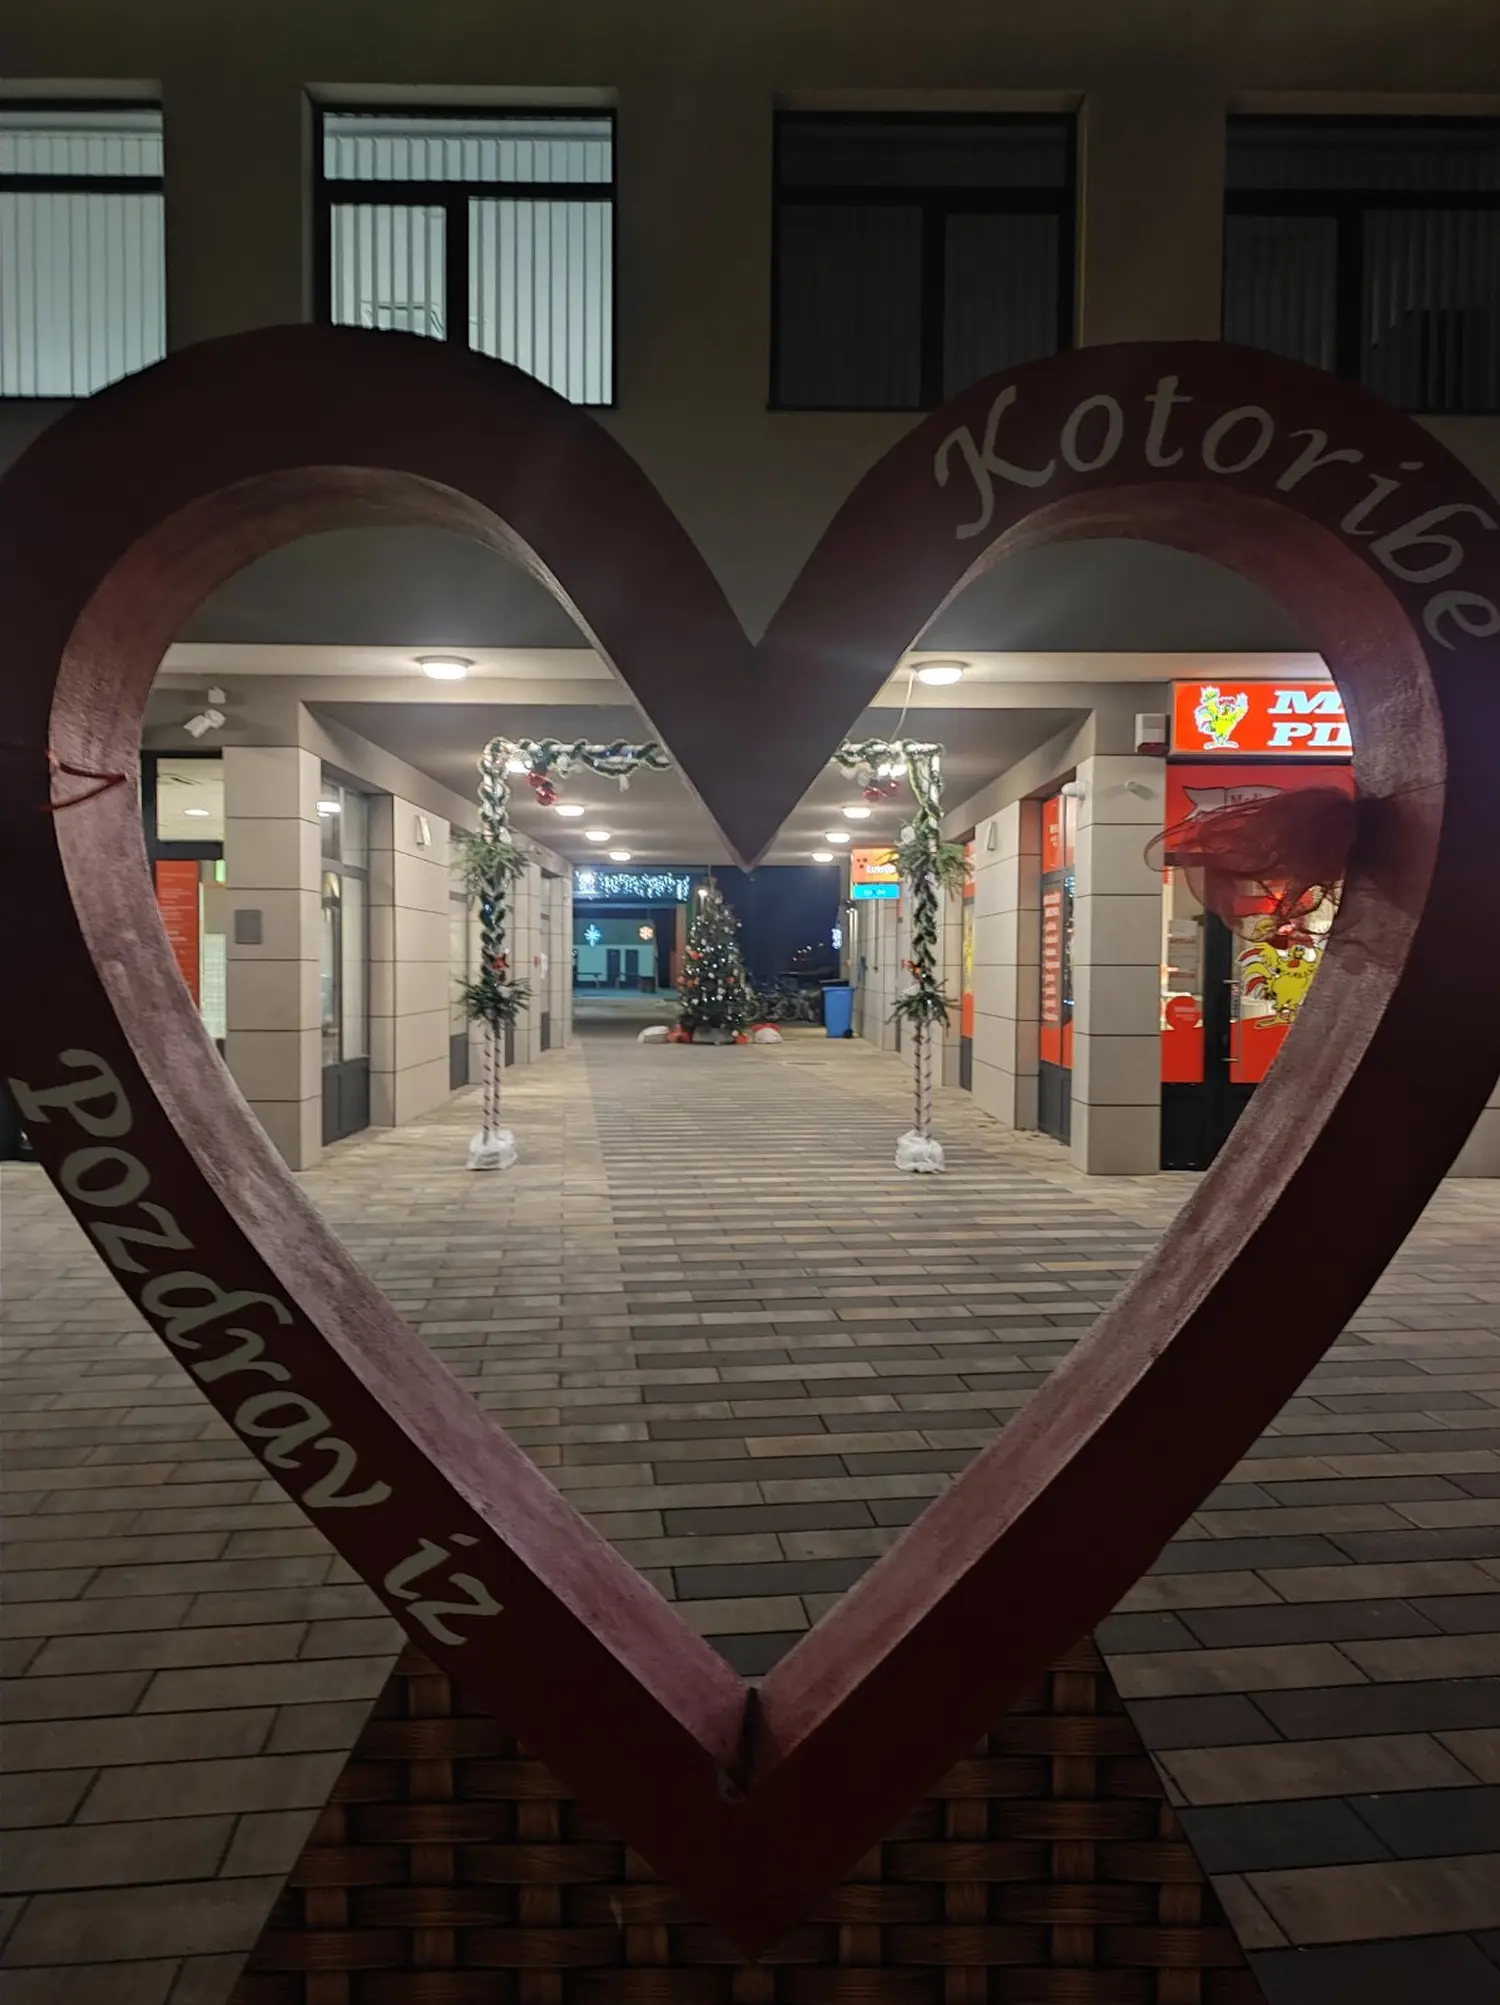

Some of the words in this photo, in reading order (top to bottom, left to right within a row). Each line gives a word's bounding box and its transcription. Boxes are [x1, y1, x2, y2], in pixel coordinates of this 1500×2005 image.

[934, 375, 1500, 650] Kotoribe
[8, 1048, 393, 1509] Pozdrav
[384, 1533, 504, 1646] iz
